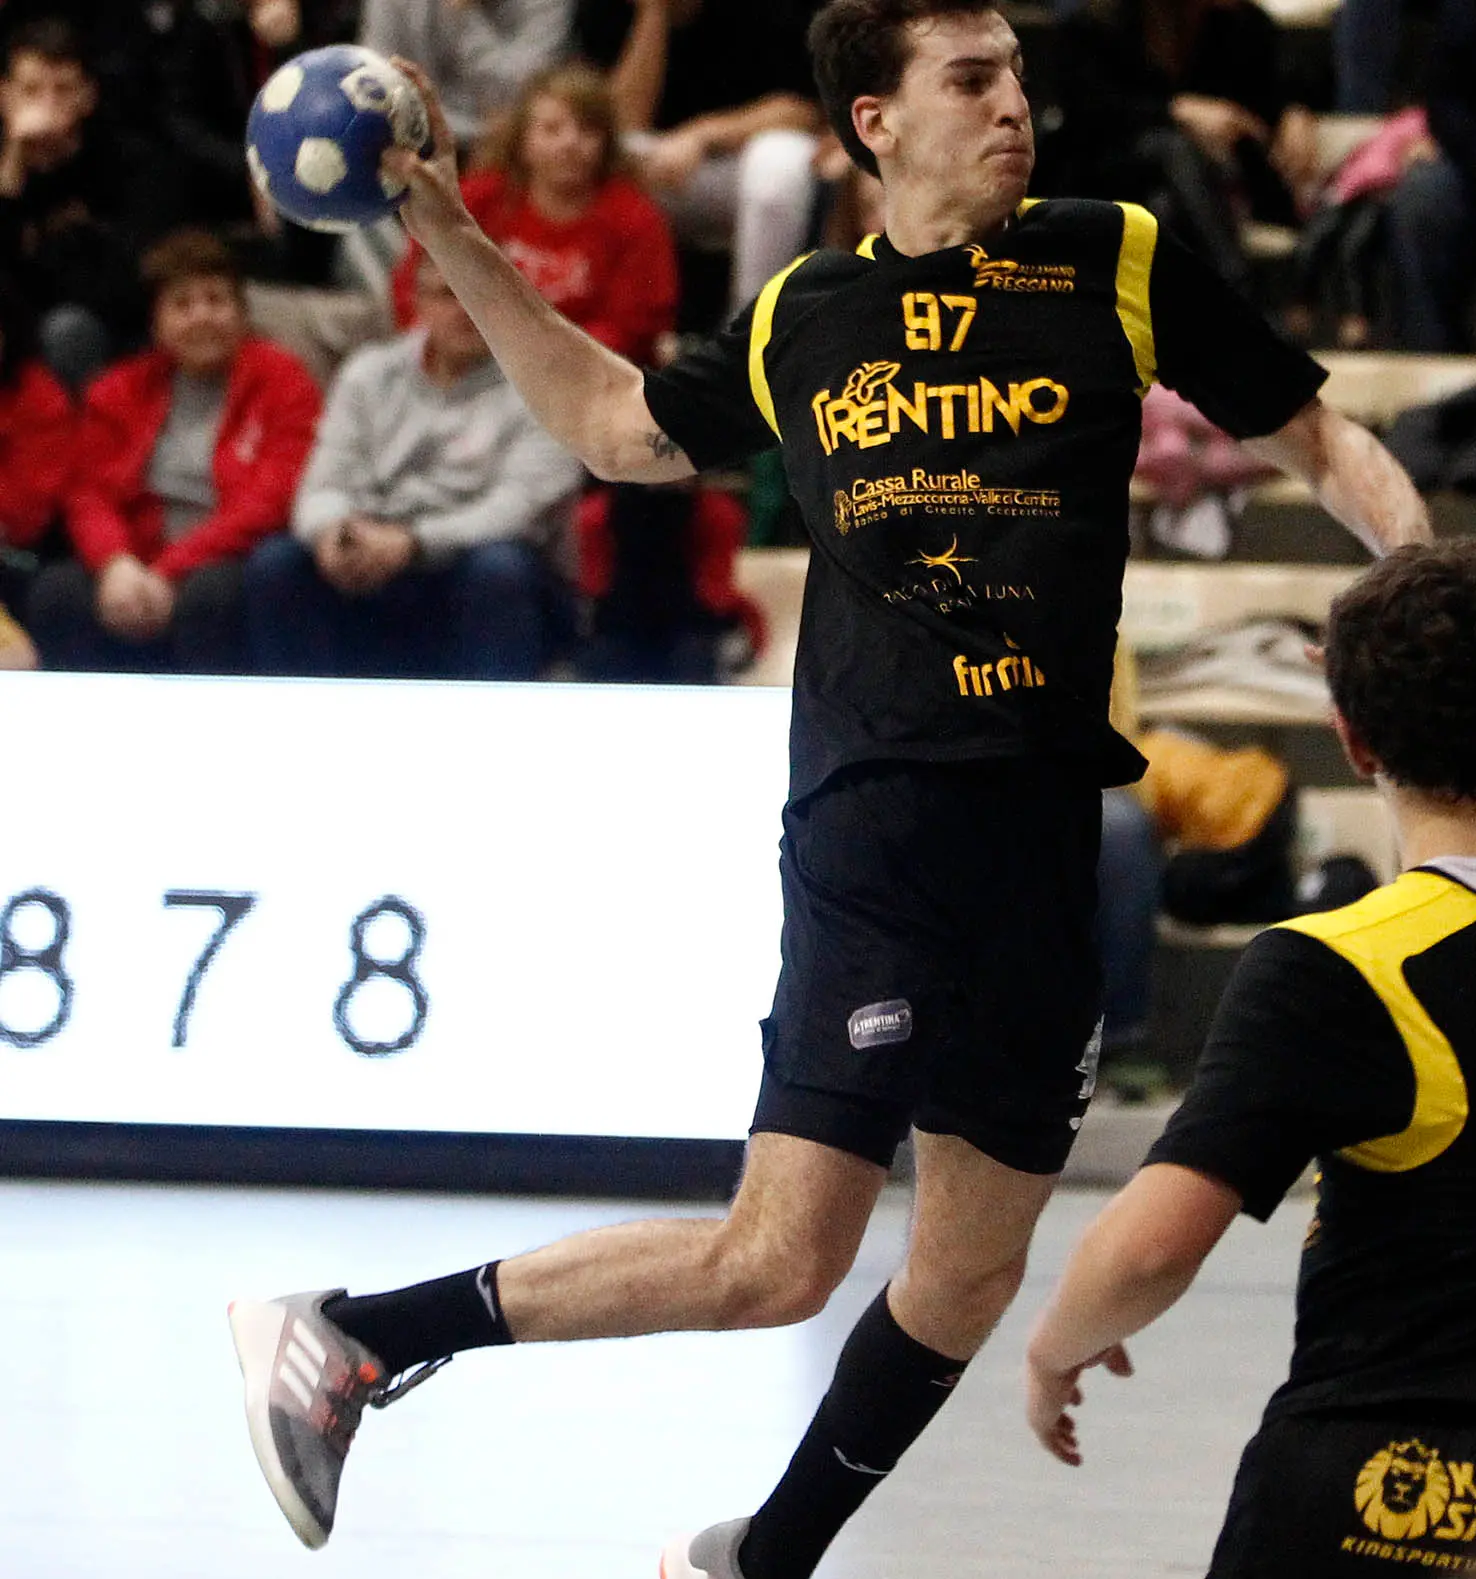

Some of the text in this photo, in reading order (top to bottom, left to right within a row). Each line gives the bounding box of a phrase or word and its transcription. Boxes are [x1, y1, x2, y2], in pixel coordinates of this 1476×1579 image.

[901, 292, 977, 352] 97
[811, 375, 1069, 455] TRENTINO
[852, 467, 981, 501] Cassa Rurale
